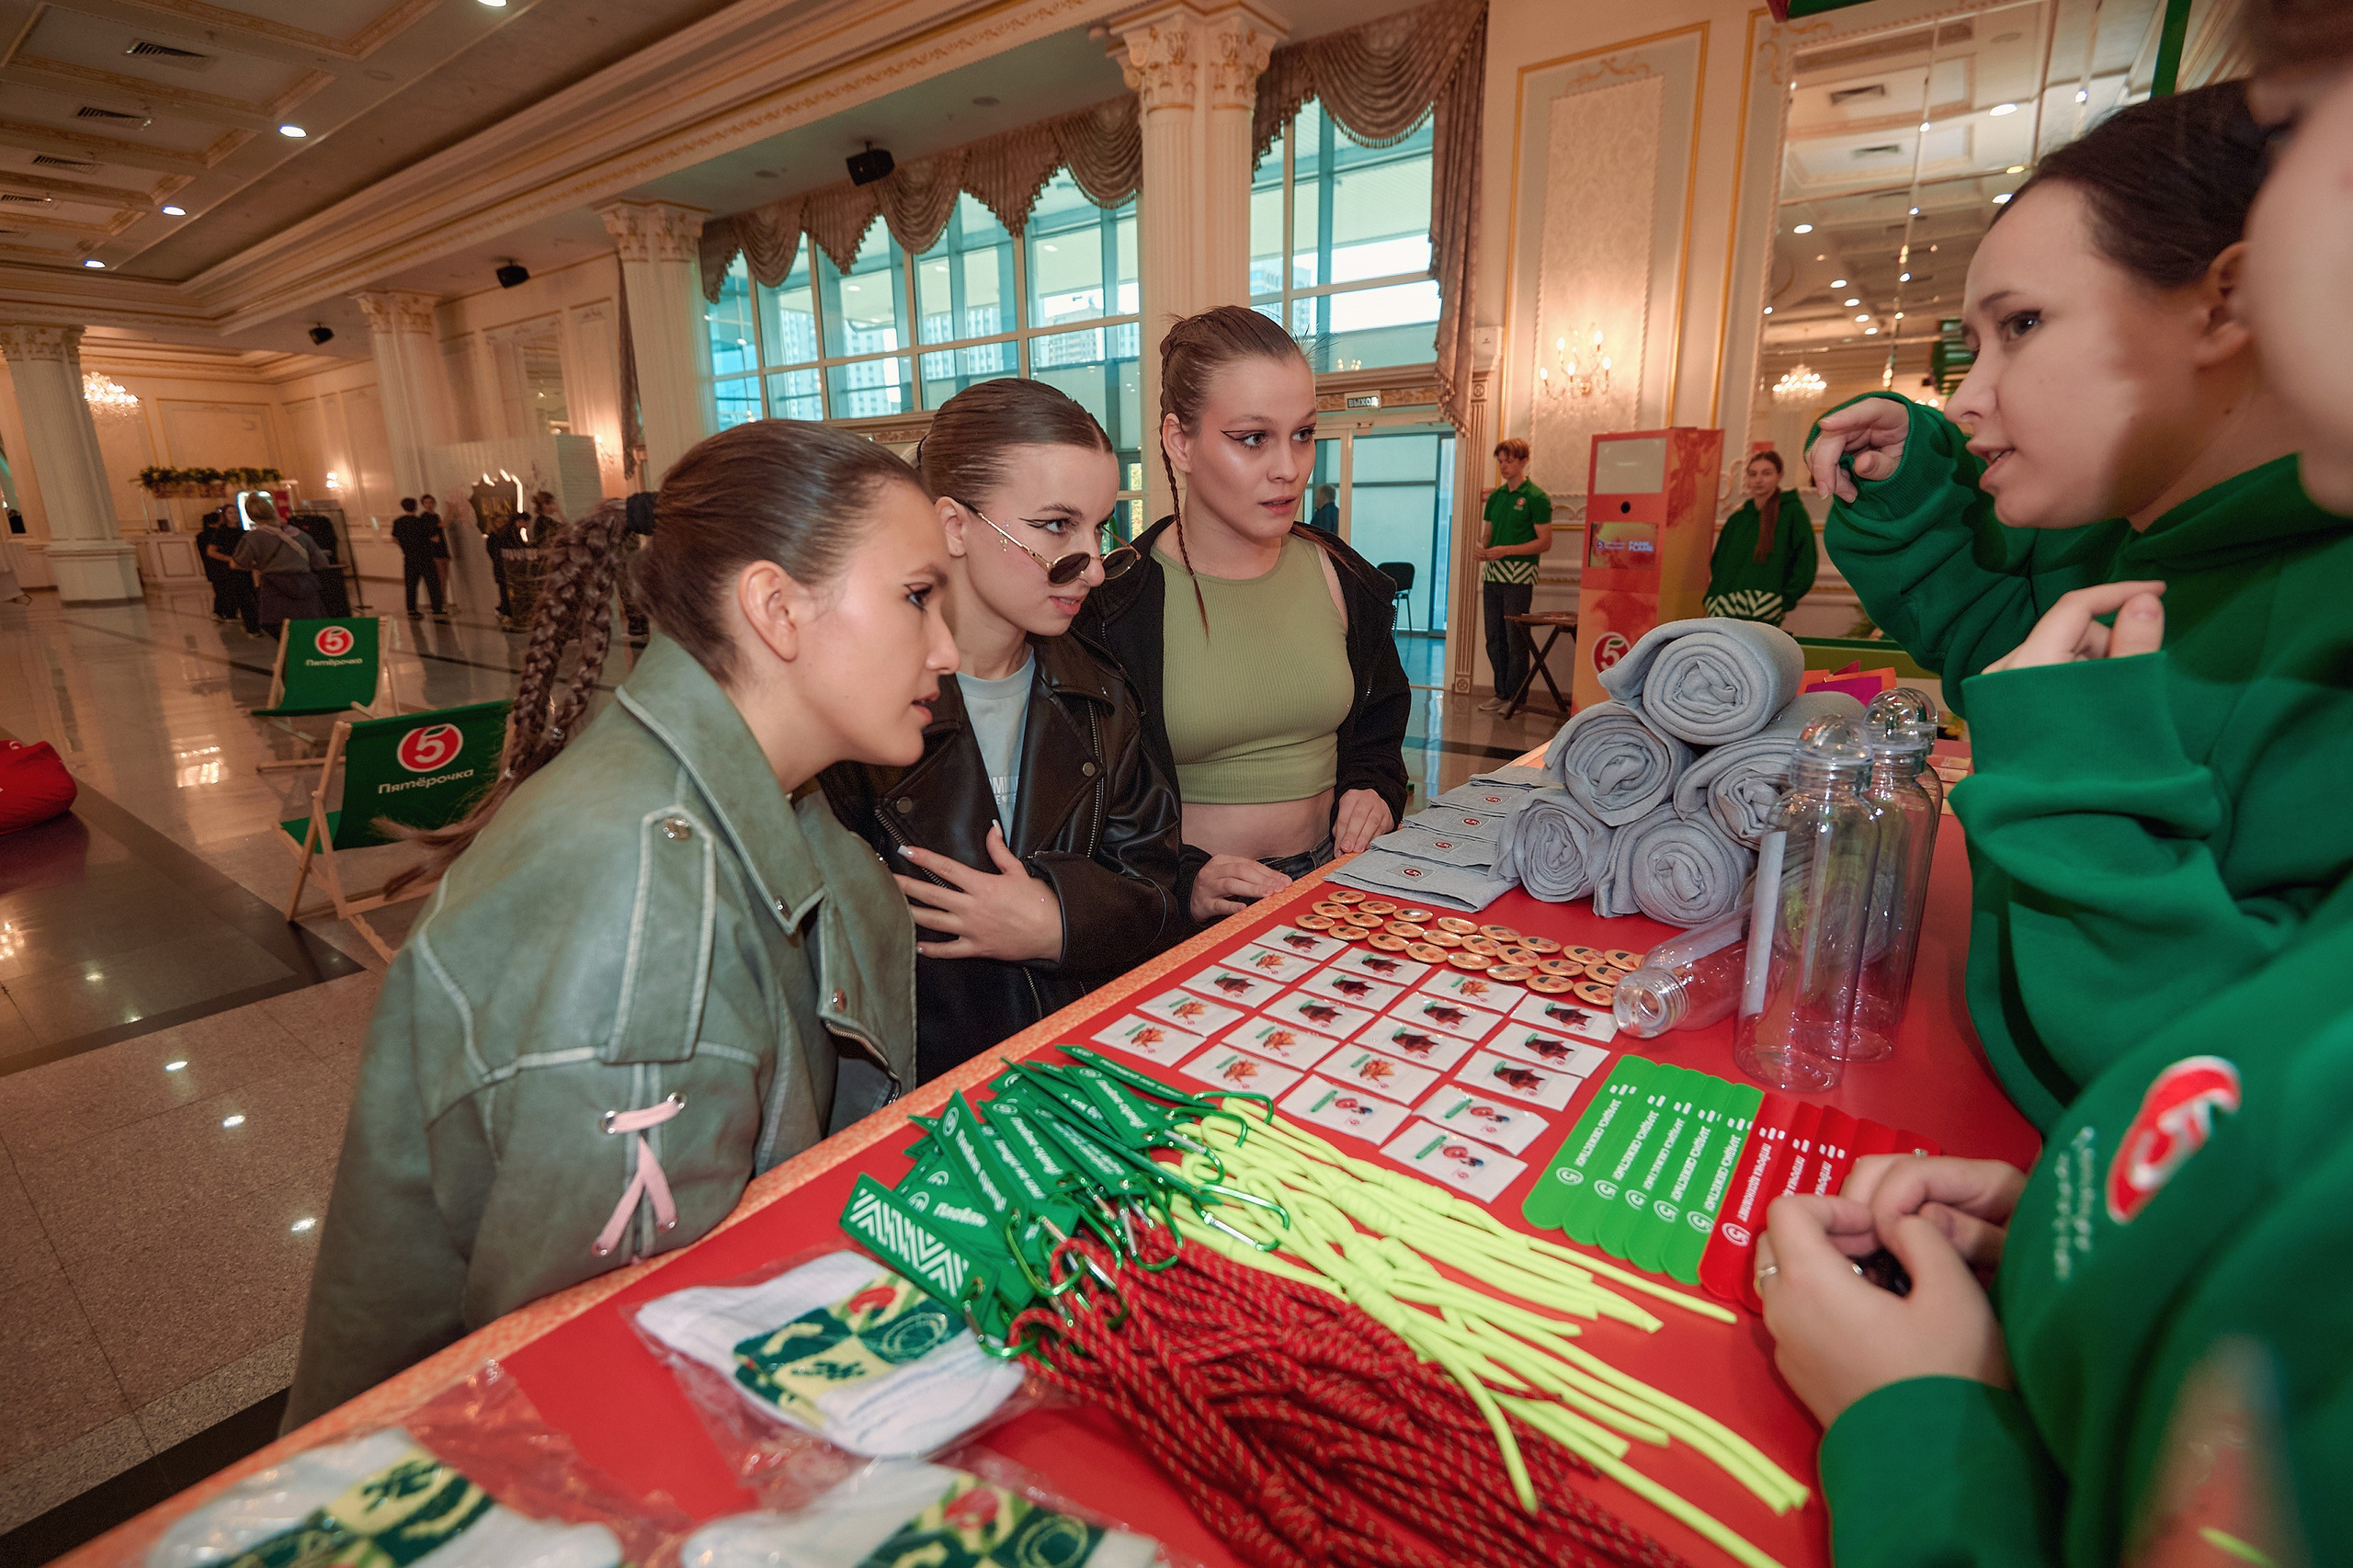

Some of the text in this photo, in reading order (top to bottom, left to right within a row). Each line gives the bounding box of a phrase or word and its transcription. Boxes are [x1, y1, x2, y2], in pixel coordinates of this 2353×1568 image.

[1348, 396, 1379, 407] ВЫХОД
[305, 657, 363, 667] Пятёрочка
[378, 768, 474, 794] Пятёрочка
[1597, 1099, 1621, 1129] ЗАРЯДИСЬ
[1635, 1110, 1659, 1142] ЗАРЯДИСЬ
[1664, 1118, 1685, 1150] ЗАРЯДИСЬ
[1689, 1126, 1711, 1160] ЗАРЯДИСЬ
[1721, 1134, 1741, 1167] ЗАРЯДИСЬ
